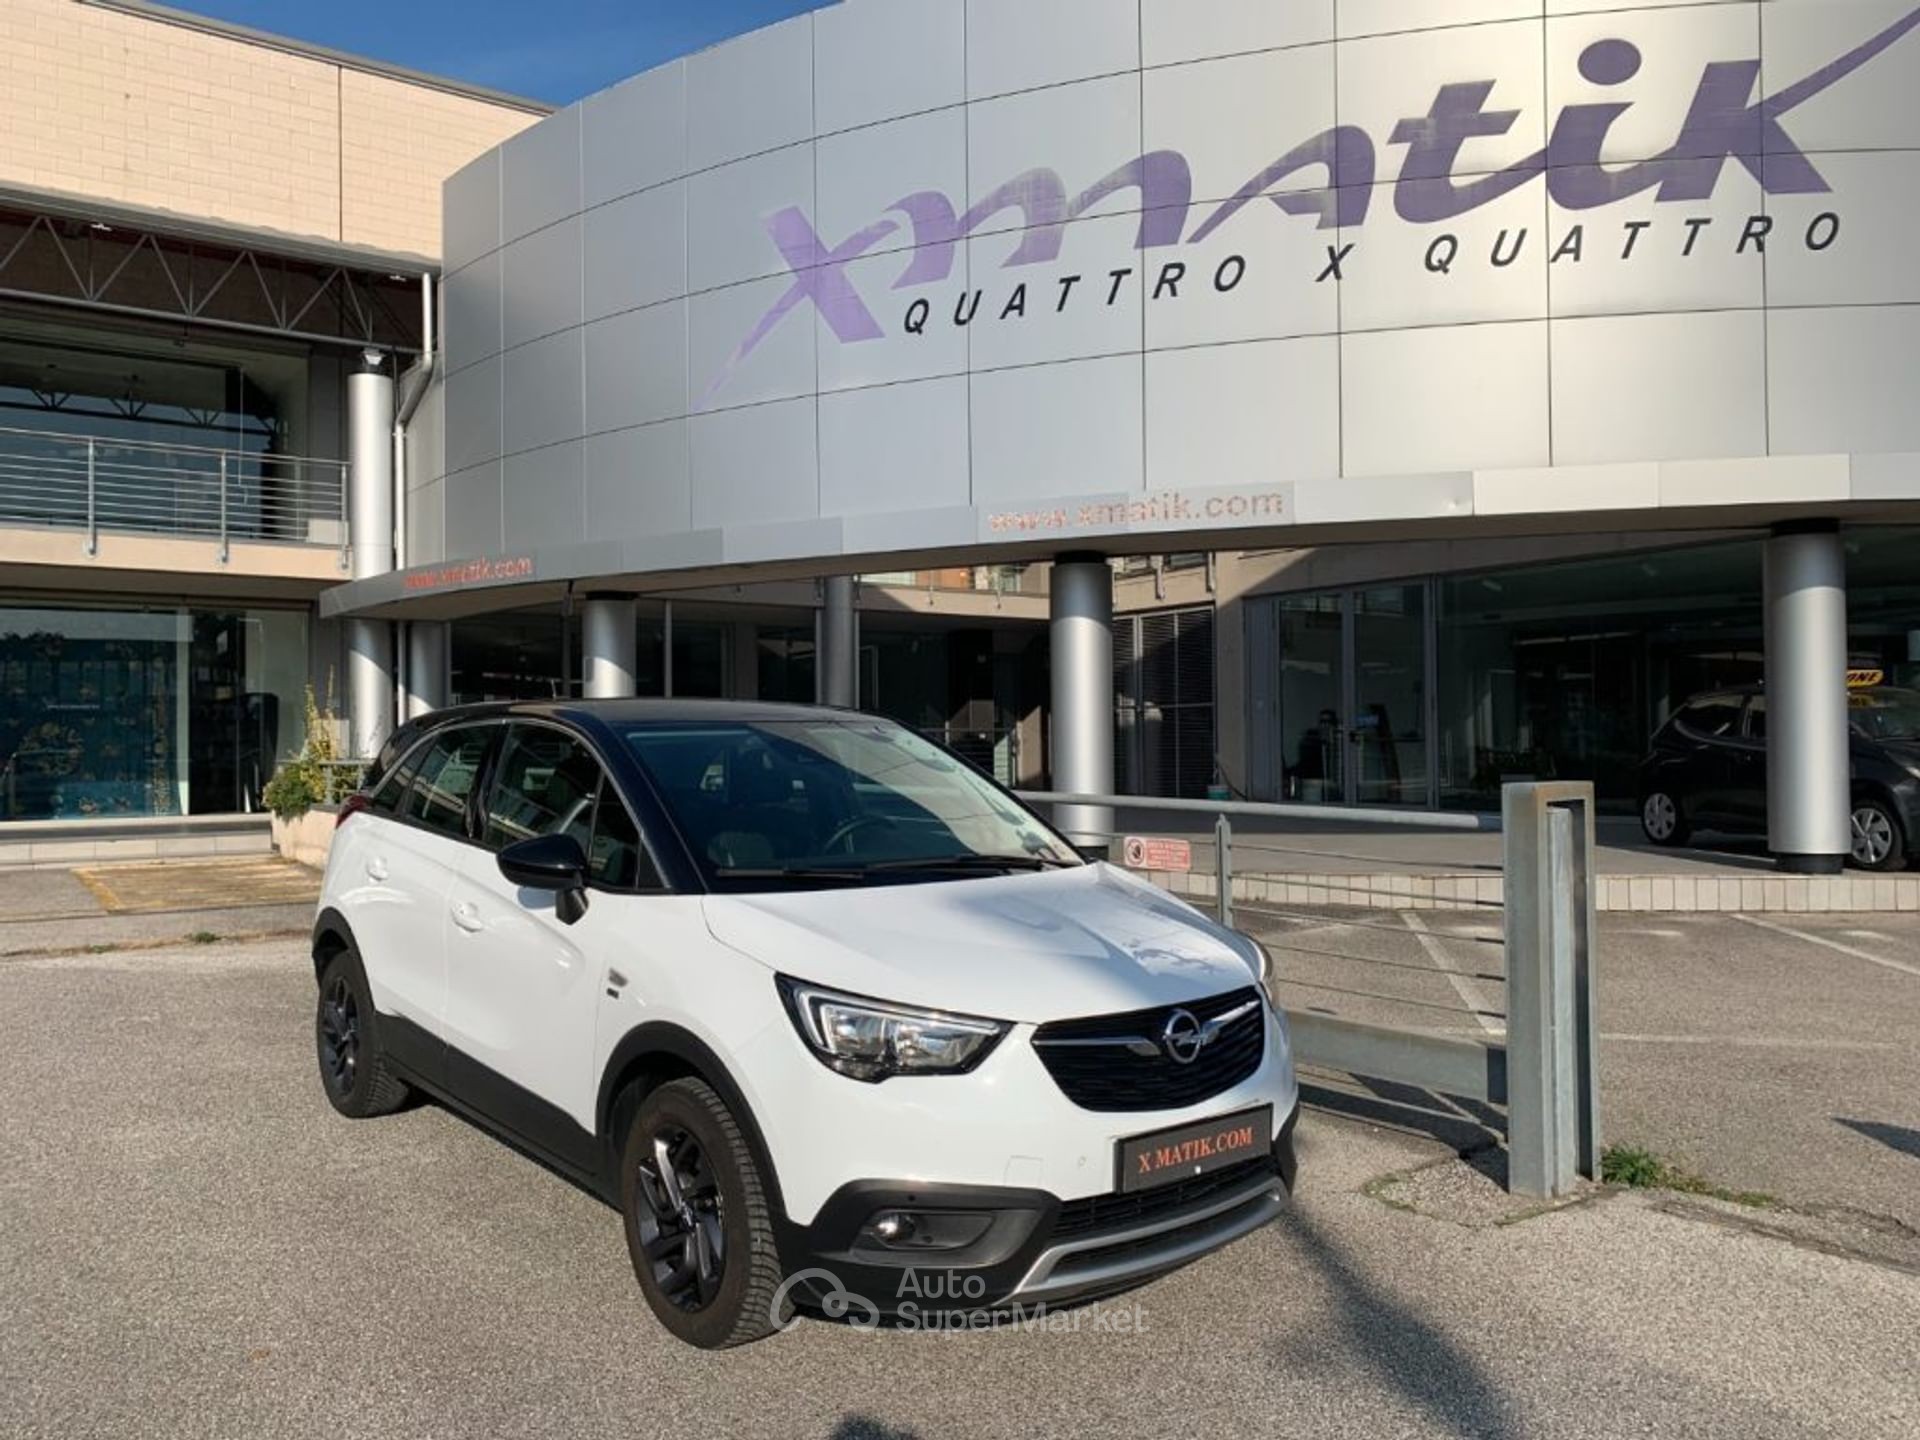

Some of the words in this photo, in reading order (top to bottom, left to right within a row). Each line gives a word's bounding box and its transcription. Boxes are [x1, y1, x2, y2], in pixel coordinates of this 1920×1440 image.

[903, 254, 1247, 335] QUATTRO
[1315, 243, 1355, 283] X
[1424, 210, 1840, 274] QUATTRO
[1139, 1153, 1150, 1173] X
[1156, 1128, 1253, 1168] MATIK.COM
